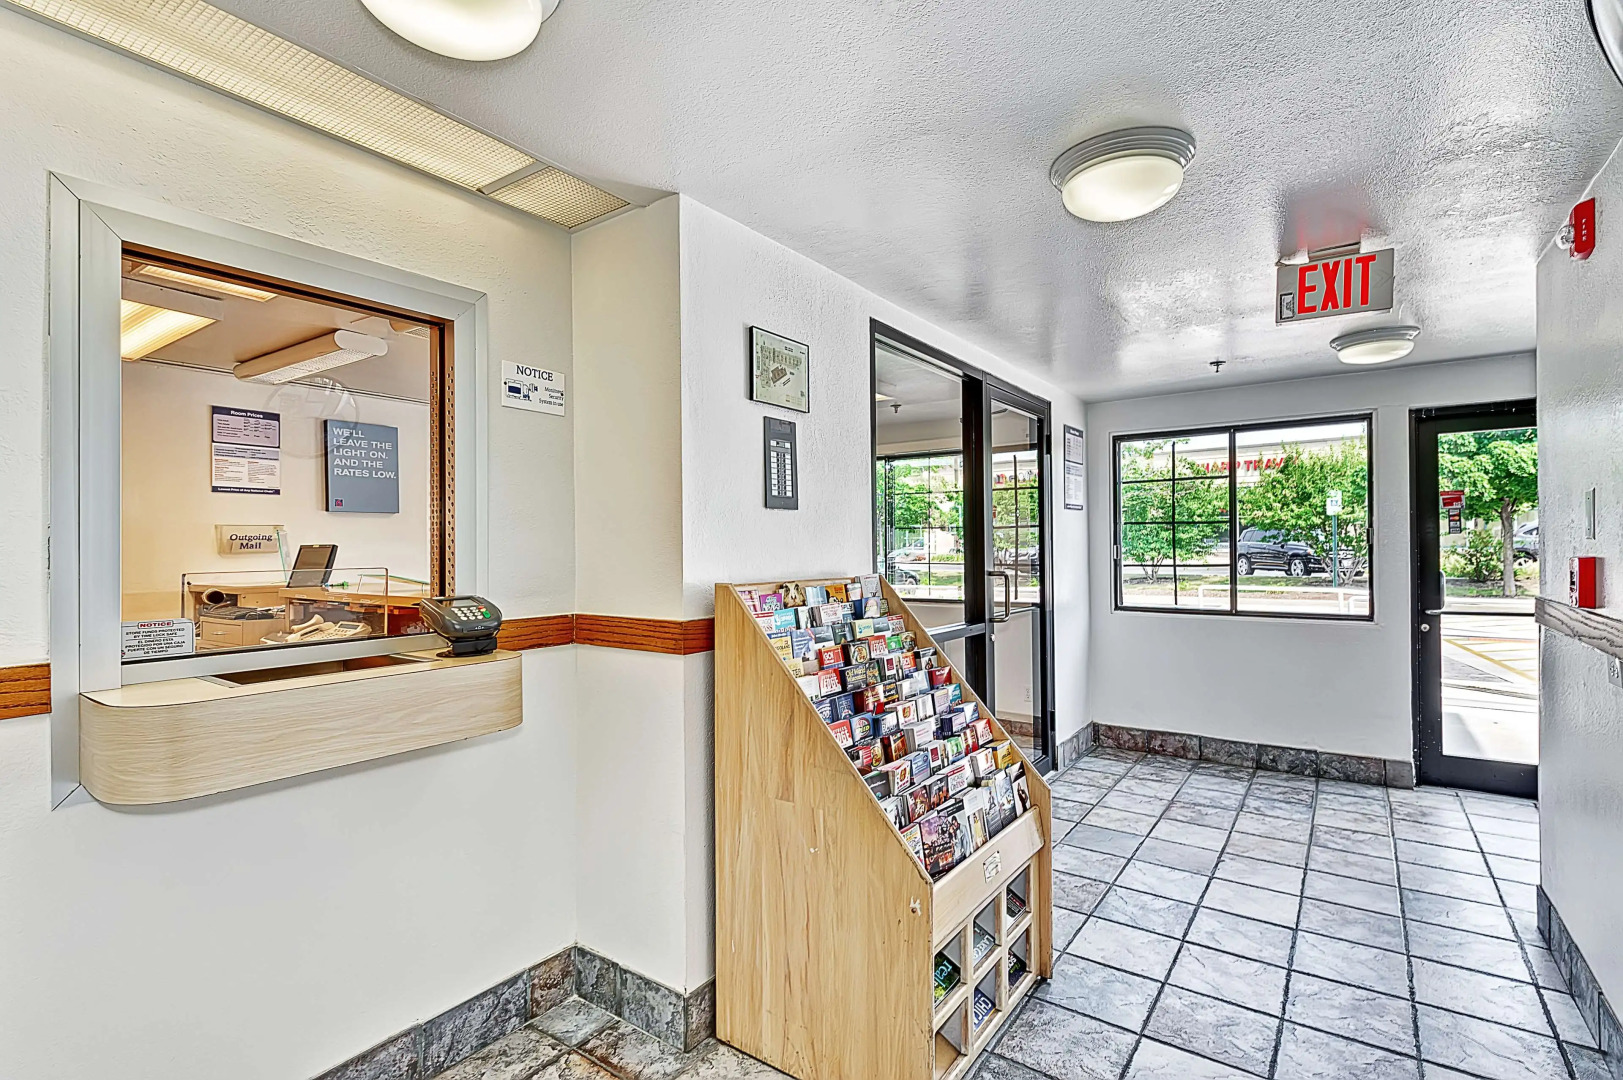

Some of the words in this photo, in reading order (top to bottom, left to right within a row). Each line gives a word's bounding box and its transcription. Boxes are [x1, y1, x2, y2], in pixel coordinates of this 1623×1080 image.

[1298, 254, 1376, 314] EXIT
[516, 364, 554, 382] NOTICE
[333, 428, 365, 438] WE'LL
[334, 438, 368, 448] LEAVE
[370, 441, 392, 450] THE
[334, 448, 367, 457] LIGHT
[370, 451, 388, 459] ON.
[334, 458, 358, 466] AND
[361, 460, 383, 468] THE
[334, 468, 369, 477] RATES
[372, 471, 396, 479] LOW.
[230, 534, 272, 542] Outgoing
